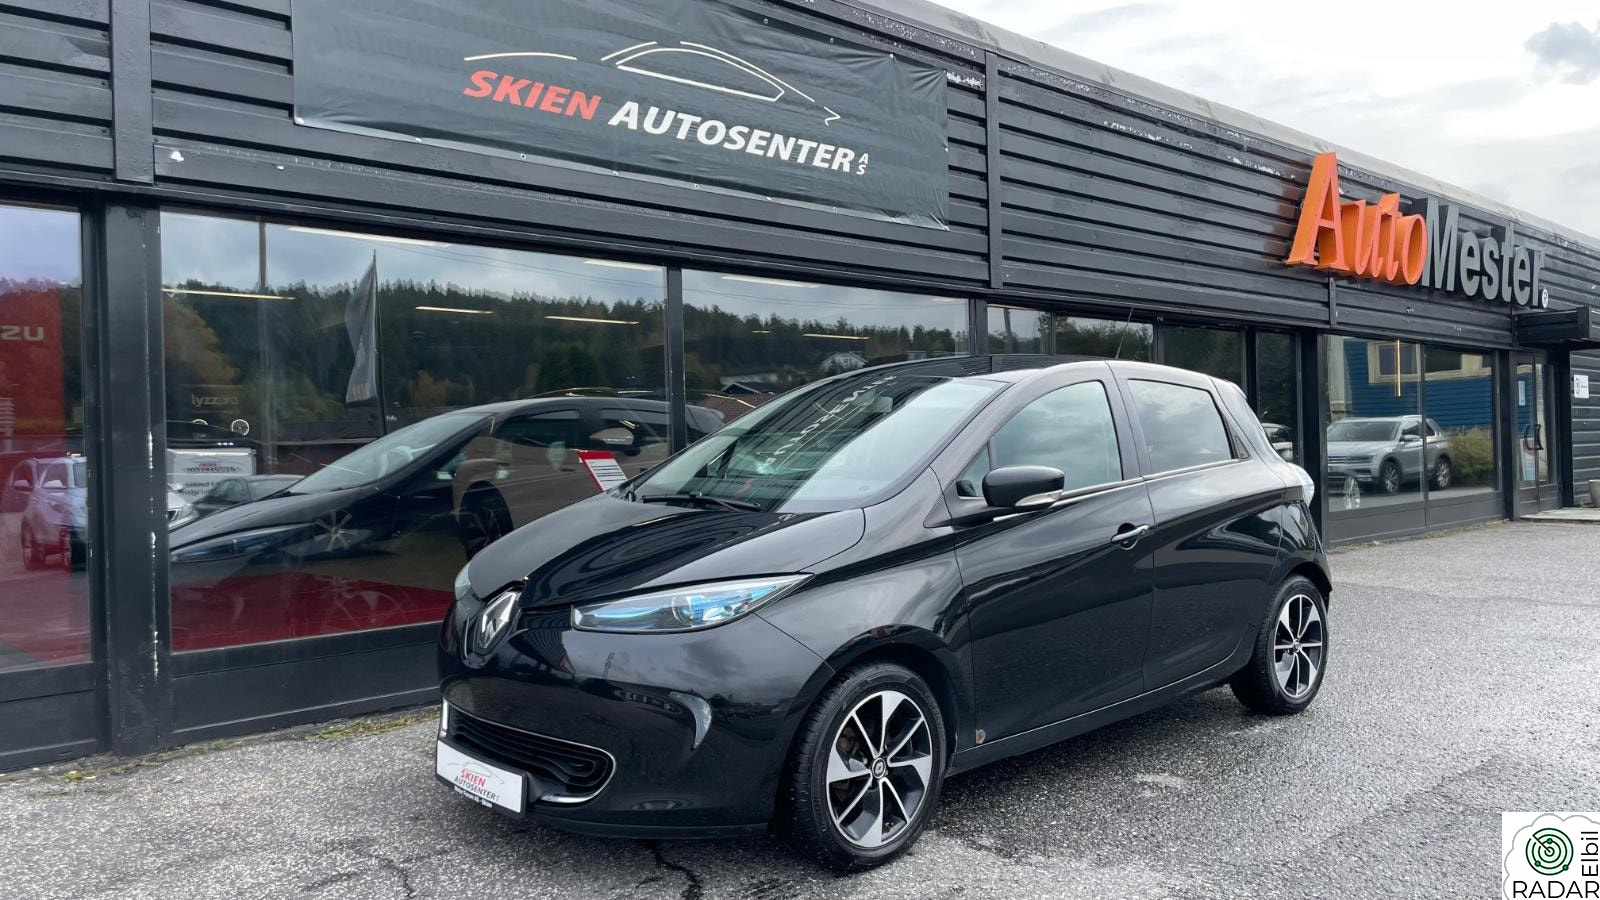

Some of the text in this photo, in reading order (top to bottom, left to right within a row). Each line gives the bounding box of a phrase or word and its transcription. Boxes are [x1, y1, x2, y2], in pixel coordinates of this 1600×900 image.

[463, 70, 602, 121] SKIEN
[608, 100, 855, 173] AUTOSENTER
[454, 776, 496, 799] AUTOSENTER
[460, 769, 486, 787] SKIEN
